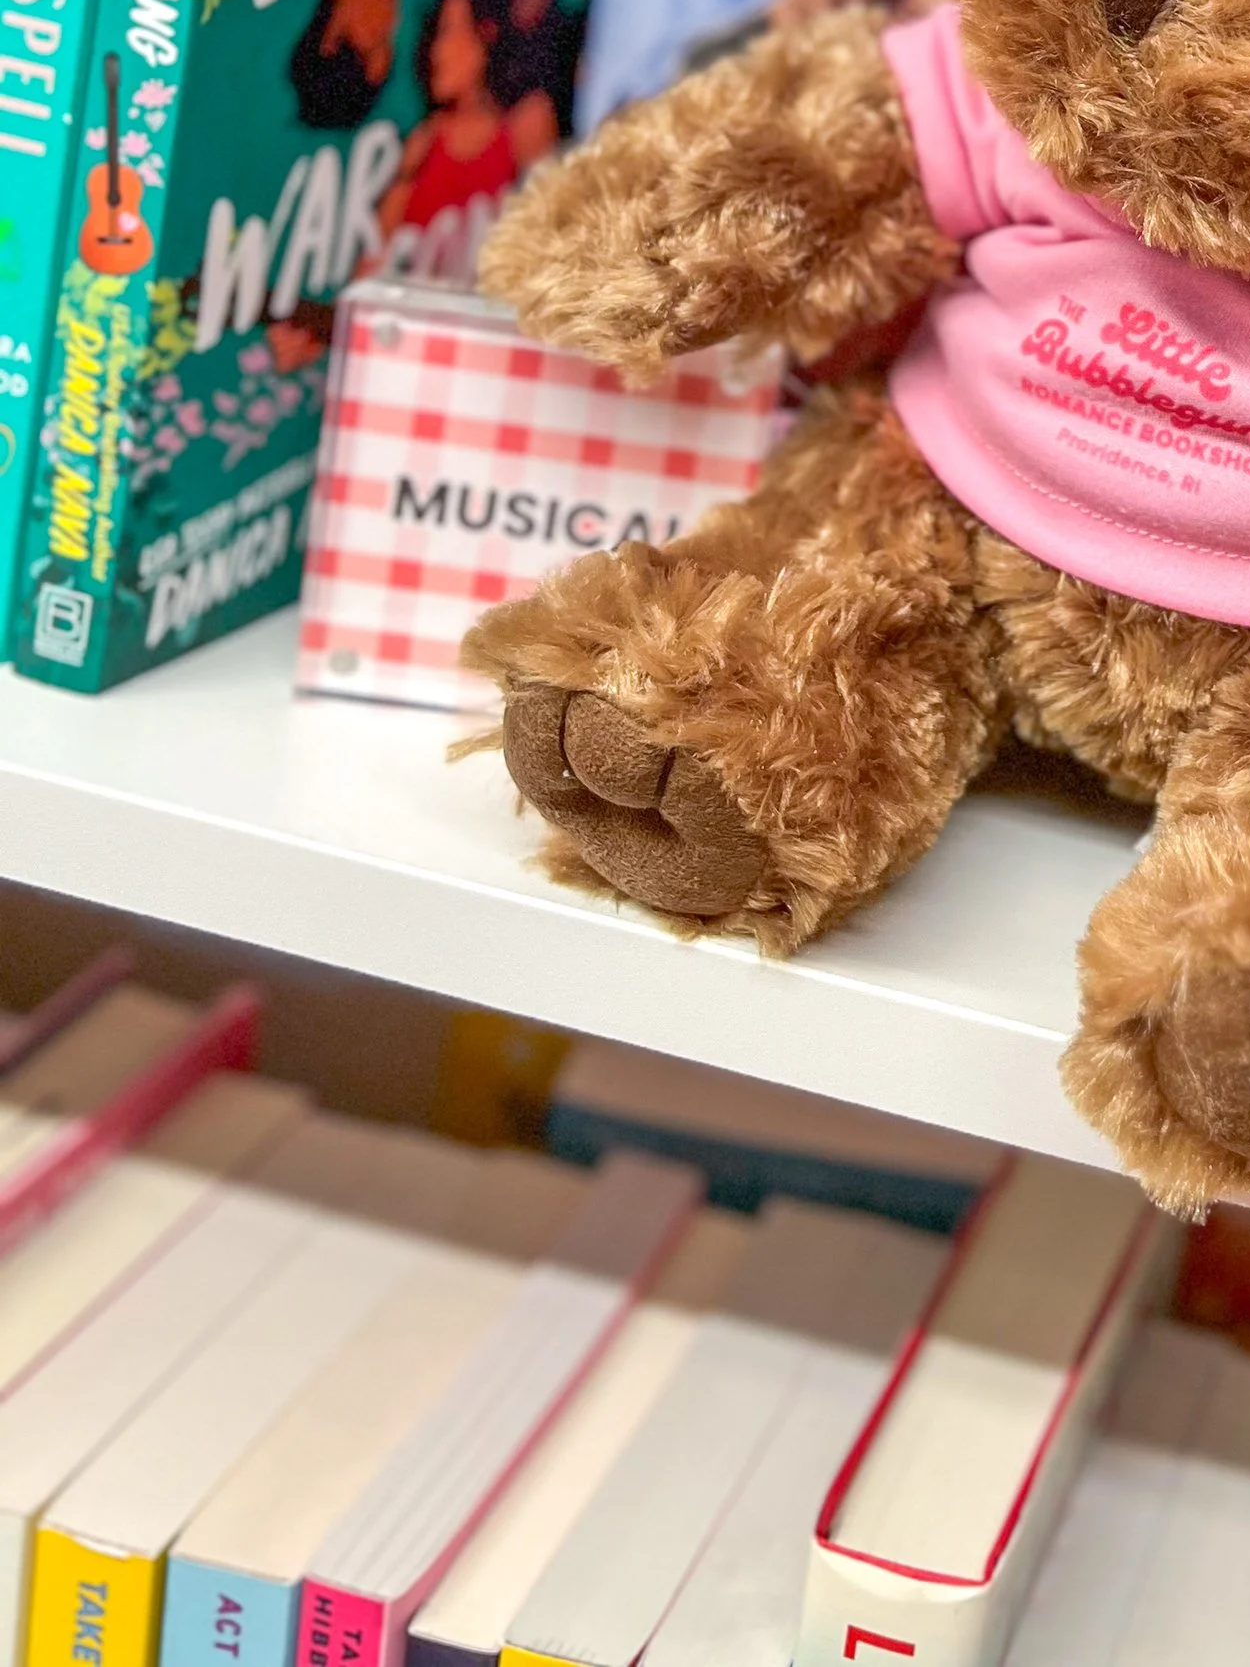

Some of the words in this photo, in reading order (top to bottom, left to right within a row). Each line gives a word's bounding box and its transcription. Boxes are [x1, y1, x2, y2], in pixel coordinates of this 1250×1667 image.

[196, 119, 402, 353] WAR
[1058, 294, 1088, 325] THE
[1100, 301, 1232, 402] Little
[58, 320, 105, 455] DANICA
[1020, 376, 1135, 435] ROMANCE
[1056, 427, 1174, 487] Providence,
[48, 461, 94, 562] NAVA
[72, 1581, 108, 1666] TAKE
[213, 1592, 244, 1659] ACT
